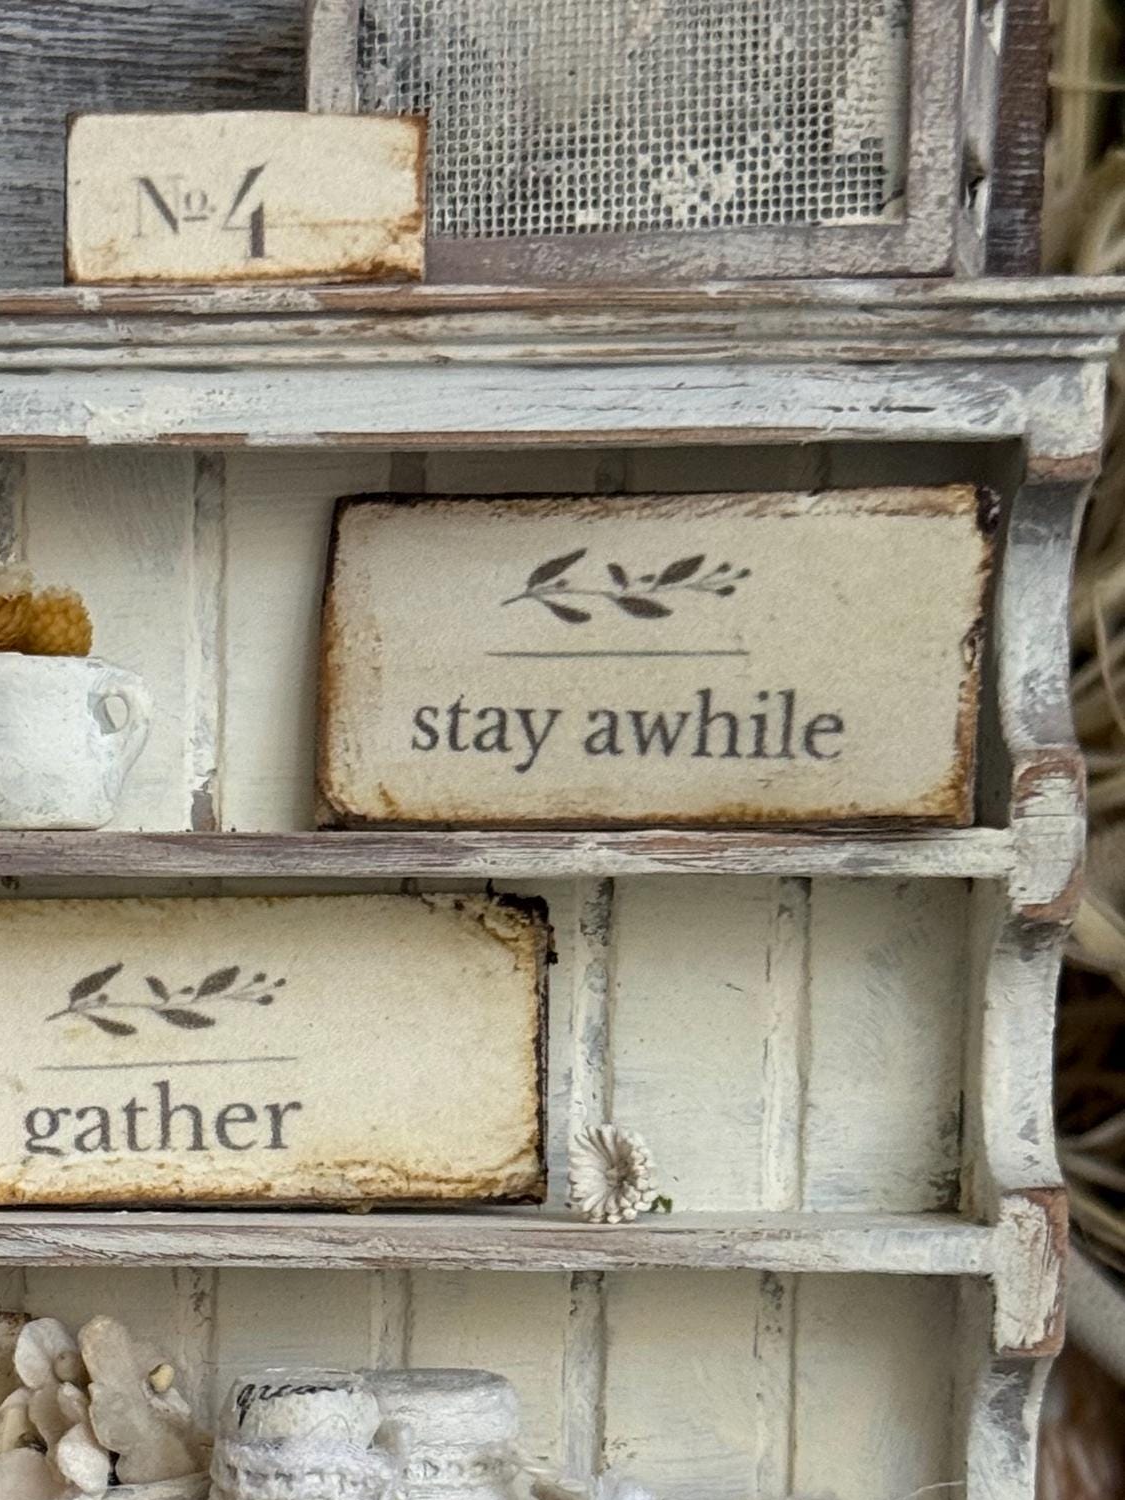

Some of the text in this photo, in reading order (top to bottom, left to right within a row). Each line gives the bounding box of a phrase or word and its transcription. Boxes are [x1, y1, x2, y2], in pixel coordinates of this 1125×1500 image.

[410, 688, 846, 773] stay awhile
[24, 1080, 303, 1156] gather
